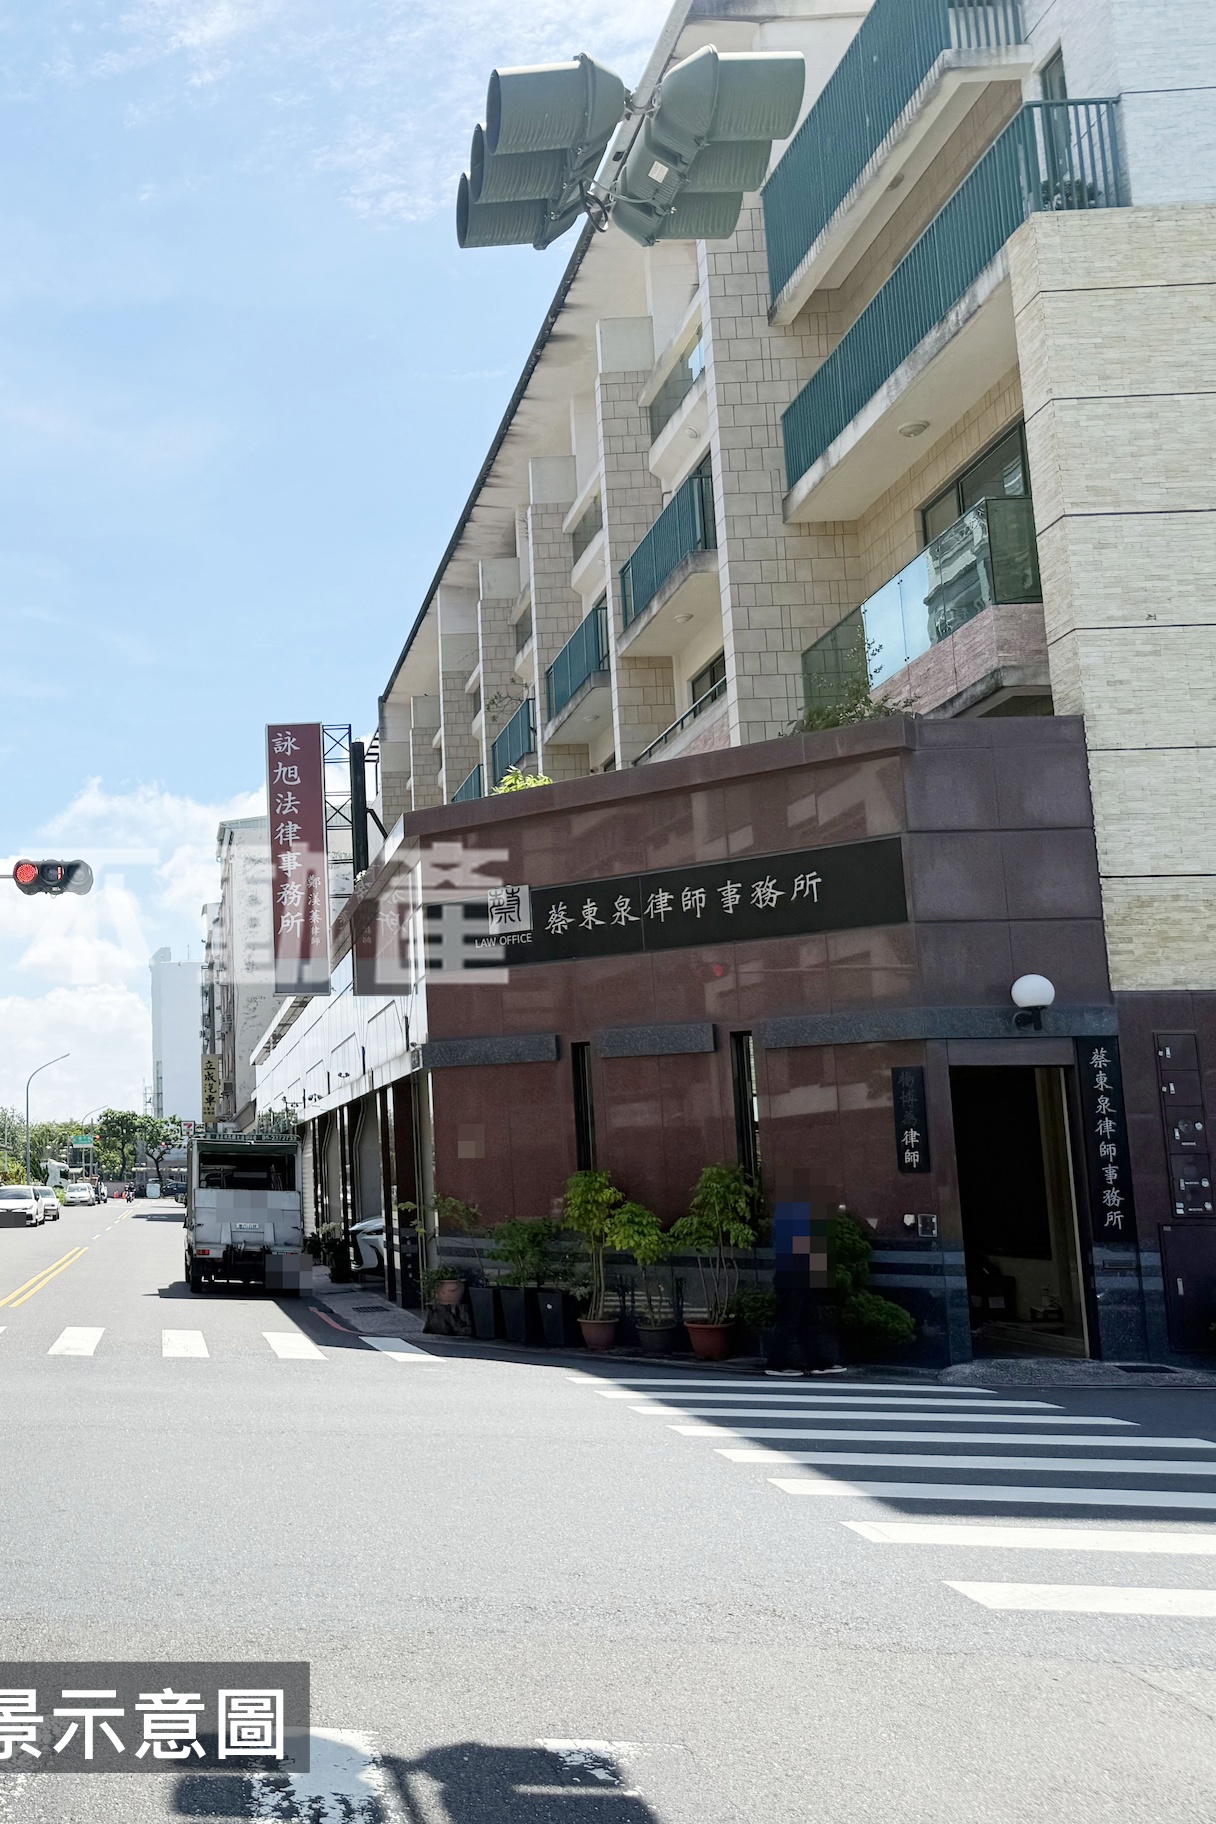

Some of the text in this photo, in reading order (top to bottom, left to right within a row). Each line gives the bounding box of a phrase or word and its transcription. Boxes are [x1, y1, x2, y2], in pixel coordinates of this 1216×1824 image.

[271, 731, 305, 938] 詠旭法律事務所
[544, 870, 822, 936] 蔡東泉律師事務所
[475, 933, 533, 949] LAW OFFICE
[204, 1060, 218, 1106] 立成汽車
[1089, 1047, 1125, 1230] 蔡東泉律師事務所
